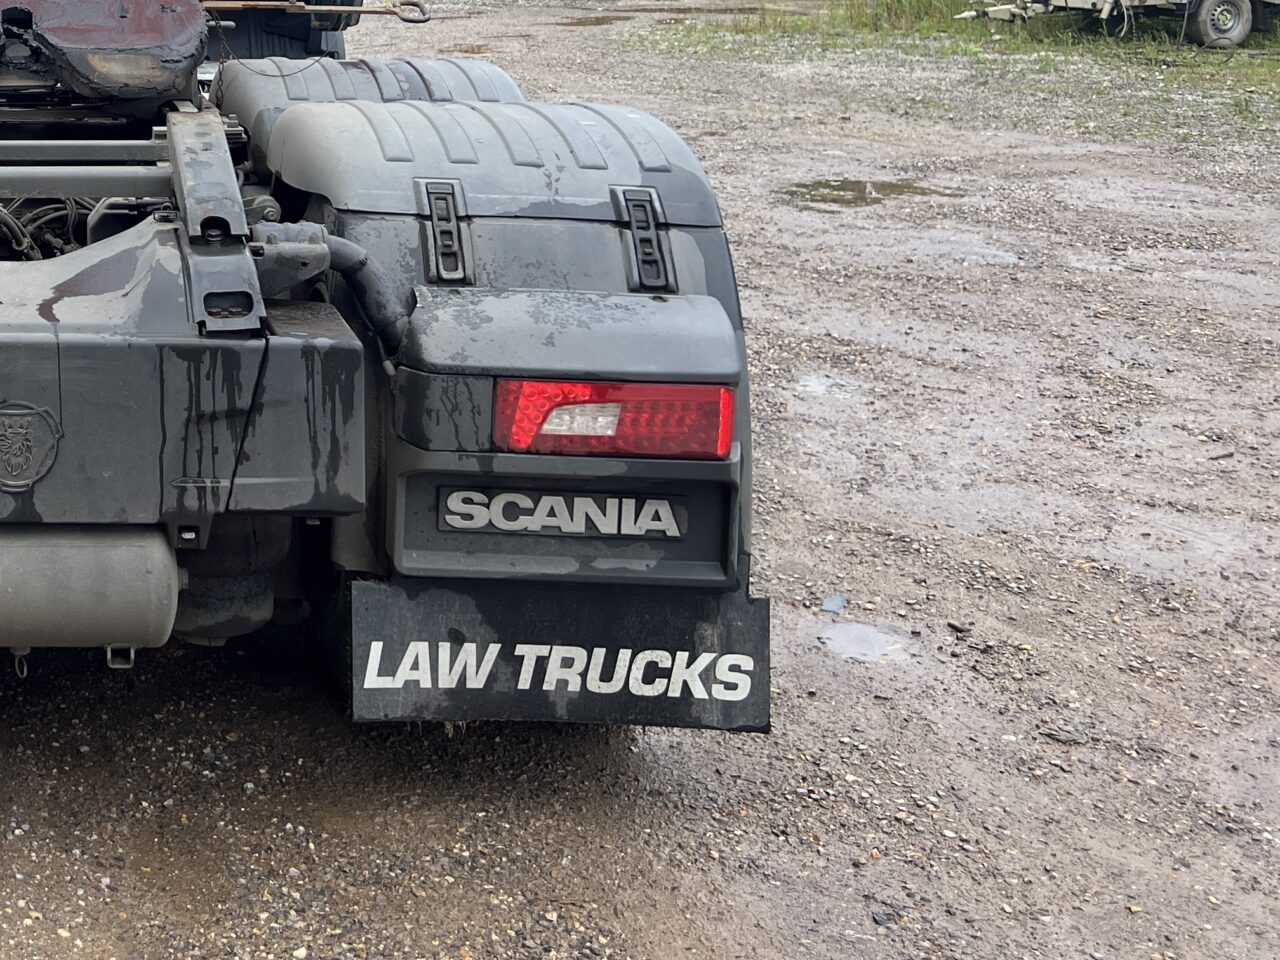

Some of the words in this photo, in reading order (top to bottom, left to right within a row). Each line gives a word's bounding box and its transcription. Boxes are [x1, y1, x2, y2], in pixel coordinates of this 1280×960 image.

[444, 490, 681, 538] SCANIA
[363, 640, 502, 690] LAW
[513, 643, 755, 702] TRUCKS
